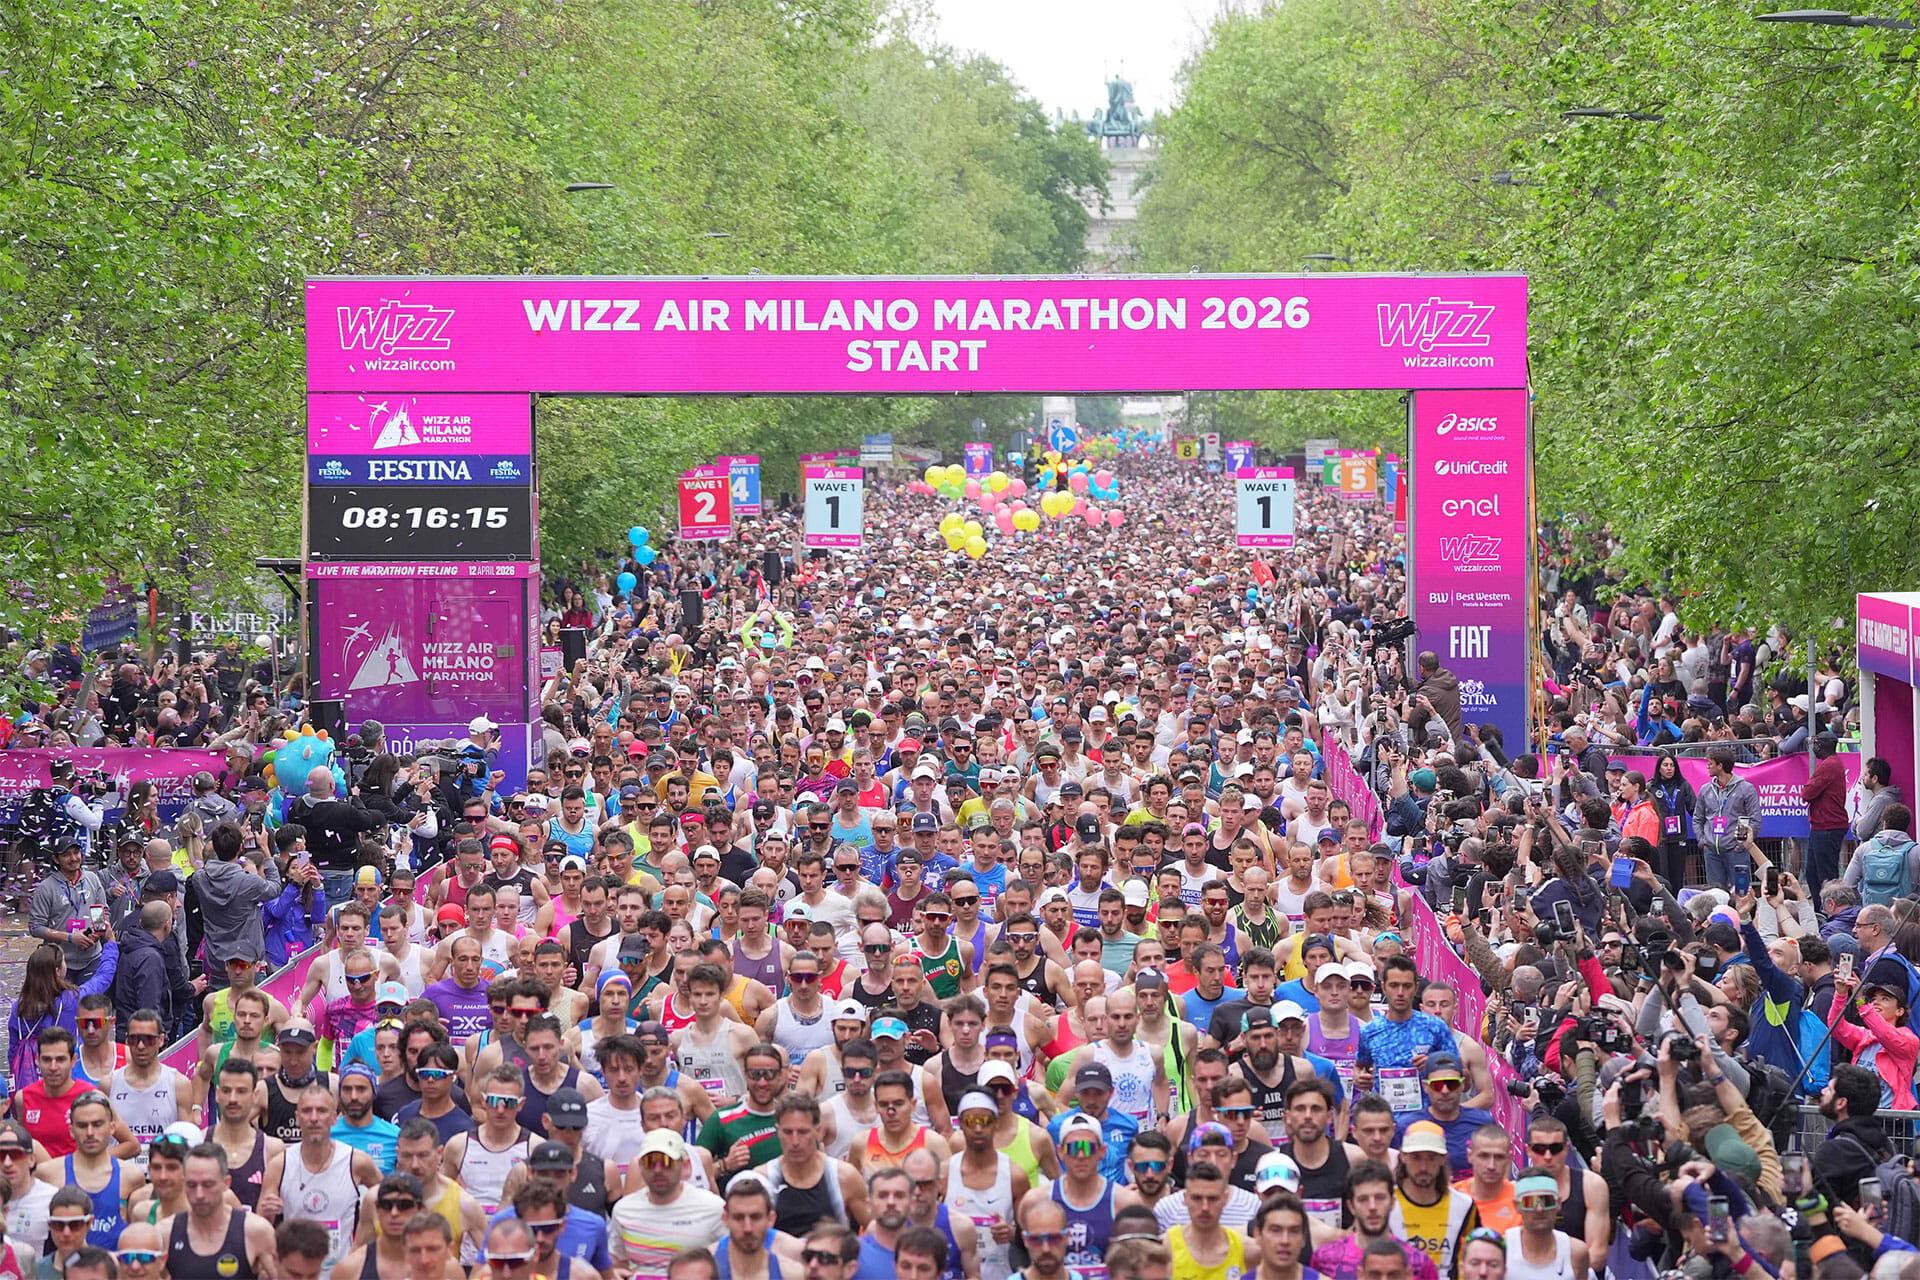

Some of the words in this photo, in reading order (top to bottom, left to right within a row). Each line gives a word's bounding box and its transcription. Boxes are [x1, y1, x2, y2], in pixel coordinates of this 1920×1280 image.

[522, 299, 641, 331] WIZZ
[653, 299, 730, 331] AIR
[744, 298, 920, 332] MILANO
[934, 297, 1186, 331] MARATHON
[1201, 296, 1310, 330] 2026
[846, 340, 987, 372] START
[1403, 354, 1494, 368] wizzair.com
[364, 357, 456, 372] wizzair.com
[422, 415, 450, 424] WIZZ
[452, 415, 471, 424] AIR
[1457, 416, 1497, 431] asics
[422, 426, 472, 435] MILANO
[1183, 445, 1191, 457] 8
[1233, 454, 1245, 471] 7
[1450, 460, 1508, 475] UniCredit
[319, 468, 349, 476] FESTINA
[368, 460, 472, 480] FESTINA
[489, 468, 521, 476] FESTINA
[730, 467, 749, 475] AVE
[1351, 467, 1367, 490] 5
[684, 480, 713, 491] WAVE
[717, 480, 723, 489] 1
[731, 476, 750, 502] 4
[813, 482, 848, 492] WAVE
[851, 483, 856, 492] 1
[1245, 482, 1279, 492] WAVE
[1282, 483, 1287, 492] 1
[694, 491, 717, 523] 2
[1442, 493, 1500, 517] enel
[342, 507, 509, 529] 08:16:15
[825, 495, 840, 529] 1
[1257, 495, 1271, 529] 1
[317, 566, 339, 576] LIVE
[341, 566, 360, 576] THE
[361, 565, 416, 576] MARATHON
[417, 565, 458, 575] FEELING
[469, 565, 477, 575] 12
[477, 565, 495, 575] APRIL
[495, 565, 515, 575] 2026
[1453, 564, 1502, 572] wizzair.com
[1429, 592, 1449, 603] BW
[1456, 592, 1475, 601] Best
[1476, 592, 1510, 601] Western
[190, 611, 280, 633] KIEFER
[422, 642, 467, 654] WIZZ
[468, 642, 493, 654] AIR
[1449, 625, 1492, 658] FIAT
[422, 655, 494, 669] MILANO
[422, 671, 494, 681] MARATHON
[1459, 693, 1498, 705] STINA
[0, 778, 17, 788] ZZ
[1759, 784, 1786, 794] WIZZ
[1789, 784, 1804, 794] AI
[452, 1016, 488, 1030] DXC
[116, 1092, 128, 1100] CT
[154, 1090, 168, 1098] CT
[1264, 1091, 1282, 1104] AIR
[276, 1125, 303, 1138] Com
